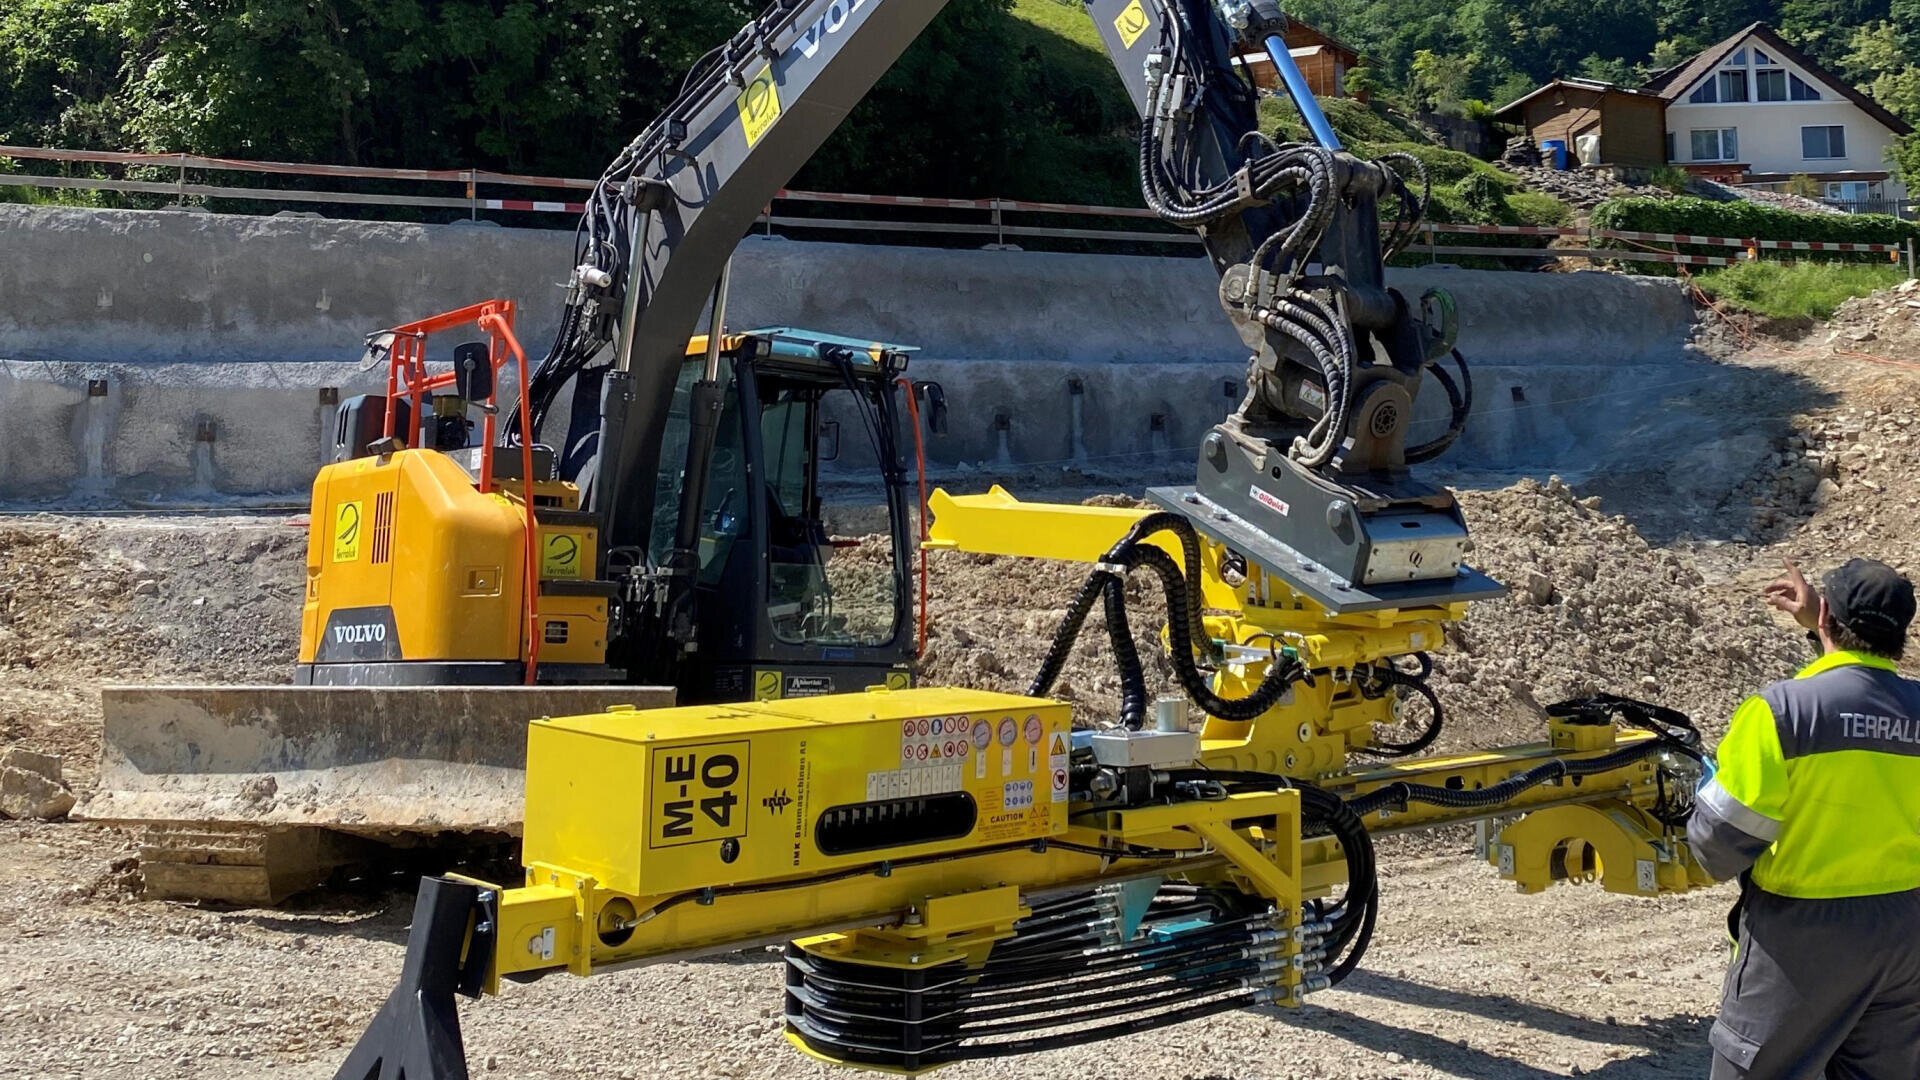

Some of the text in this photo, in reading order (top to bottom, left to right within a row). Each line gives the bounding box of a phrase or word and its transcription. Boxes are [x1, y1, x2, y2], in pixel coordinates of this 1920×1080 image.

[792, 0, 865, 59] VO
[334, 624, 386, 643] VOLVO
[663, 754, 696, 838] M-E
[700, 754, 739, 828] 40
[990, 813, 1023, 823] CAUTION
